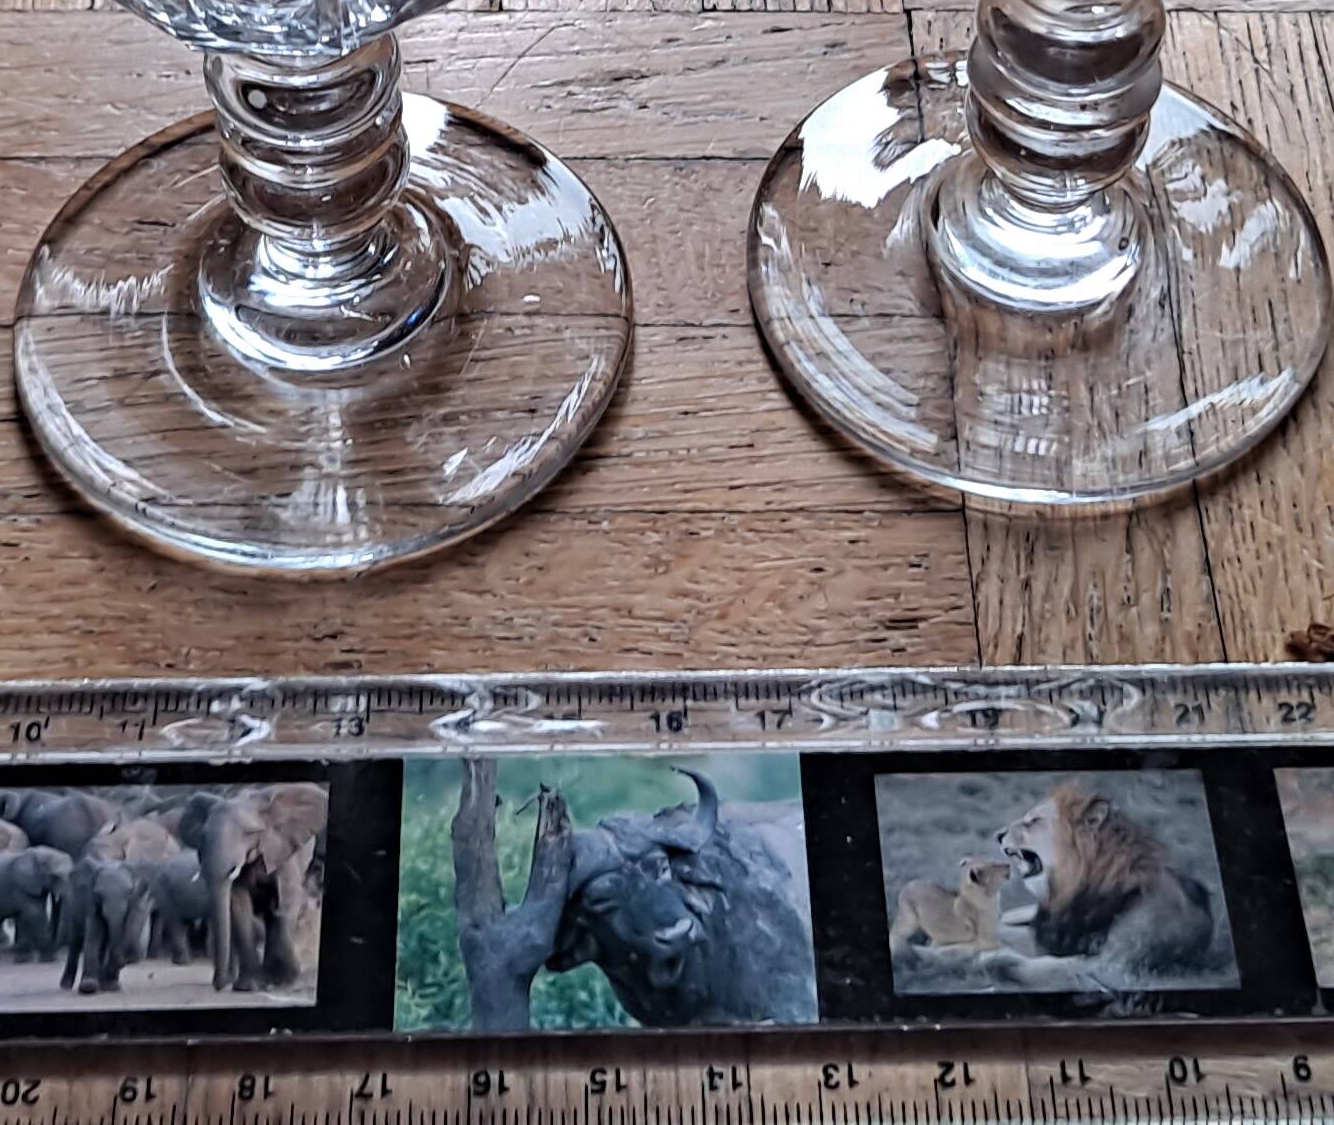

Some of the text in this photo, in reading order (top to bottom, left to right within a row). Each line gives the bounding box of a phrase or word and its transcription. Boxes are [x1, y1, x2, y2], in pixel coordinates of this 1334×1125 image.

[1175, 703, 1206, 725] 21
[1277, 701, 1314, 722] 22
[590, 1068, 626, 1093] 15
[706, 1066, 742, 1091] 14
[823, 1062, 858, 1089] 13
[938, 1061, 975, 1088] 12
[1060, 1059, 1091, 1085] 11
[1169, 1057, 1206, 1084] 10
[1293, 1055, 1311, 1082] 9
[1, 1079, 41, 1105] 20
[120, 1077, 156, 1102] 19
[238, 1074, 274, 1100] 18
[355, 1073, 391, 1098] 17
[473, 1070, 509, 1096] 16
